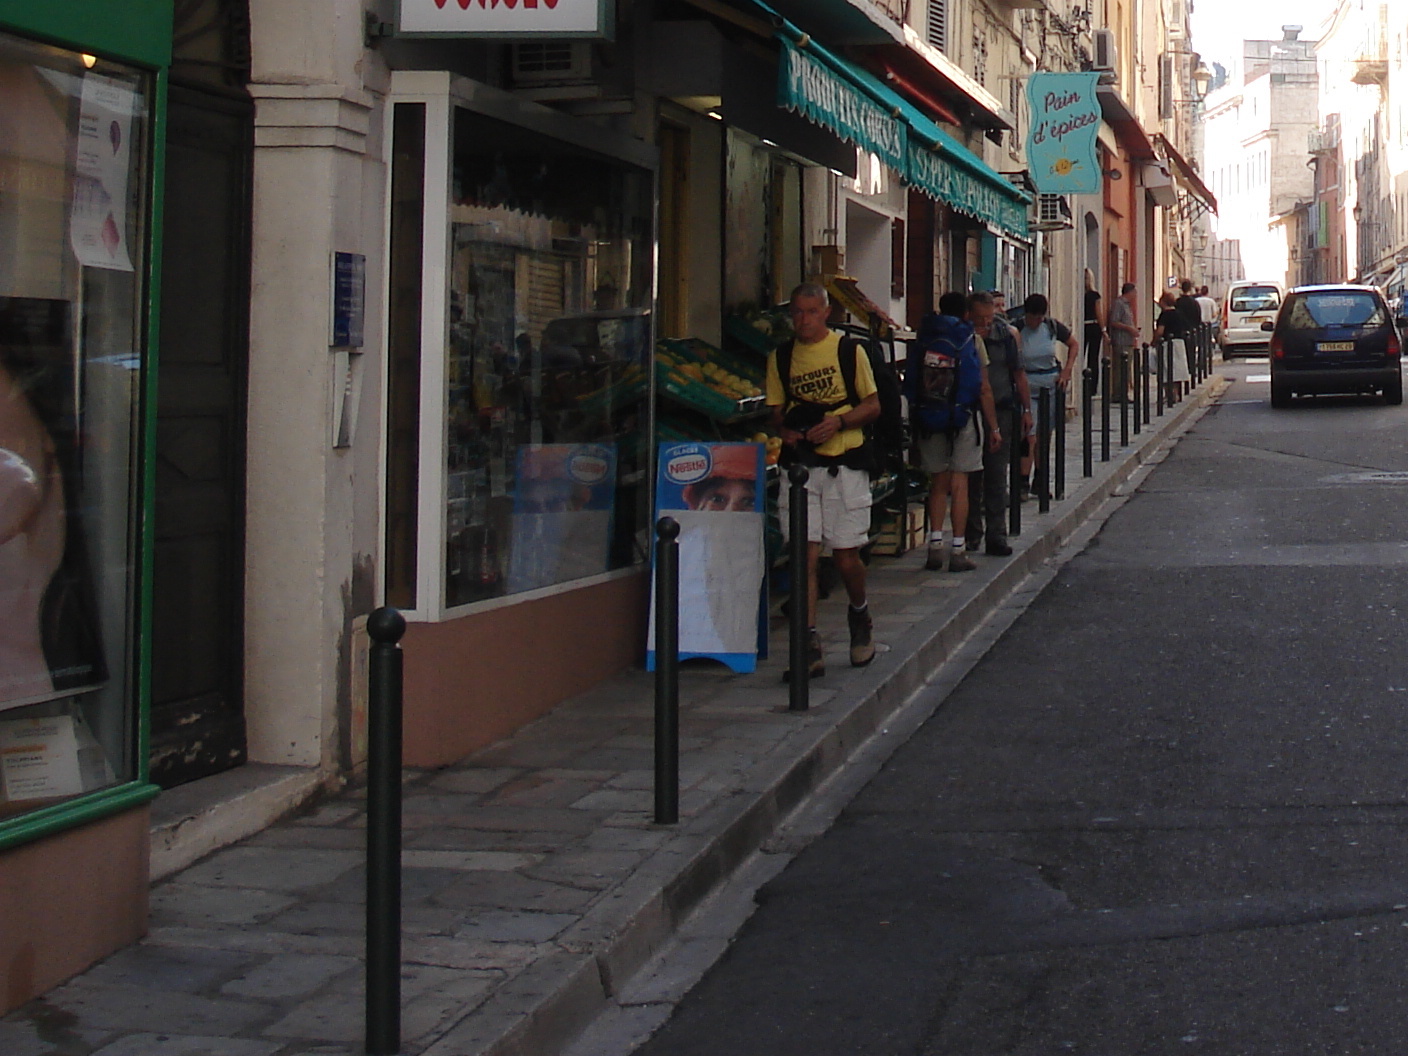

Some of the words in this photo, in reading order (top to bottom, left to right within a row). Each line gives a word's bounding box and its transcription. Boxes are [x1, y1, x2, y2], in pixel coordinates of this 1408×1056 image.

[789, 48, 860, 132] PRODUITS
[860, 101, 901, 159] CORSES
[1044, 90, 1081, 114] Pain
[1034, 111, 1099, 145] d'épices
[791, 366, 837, 384] ARCOURS
